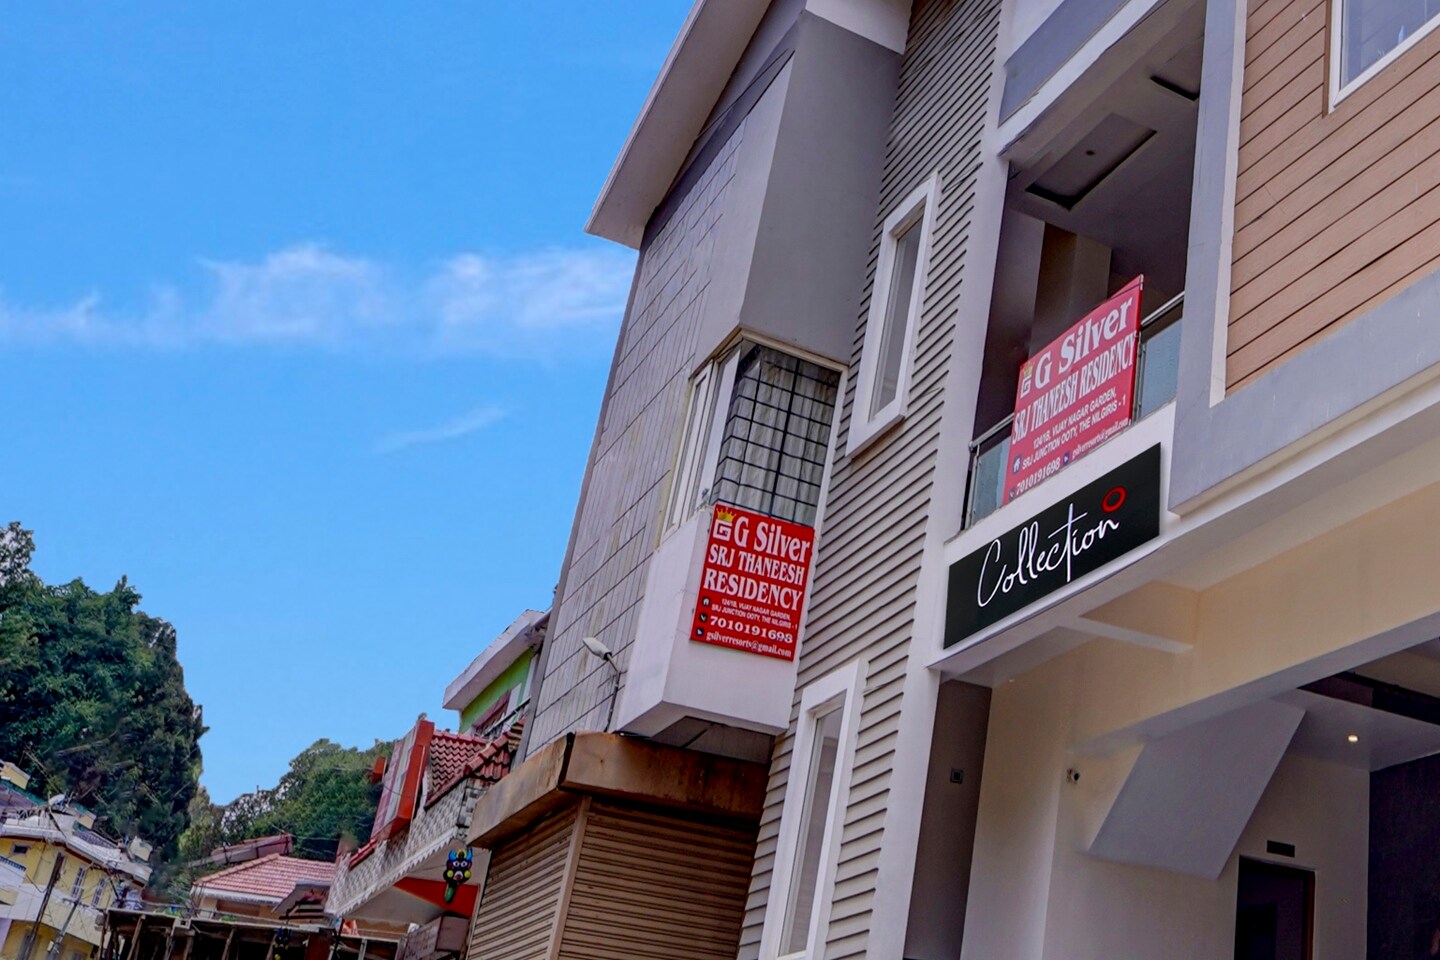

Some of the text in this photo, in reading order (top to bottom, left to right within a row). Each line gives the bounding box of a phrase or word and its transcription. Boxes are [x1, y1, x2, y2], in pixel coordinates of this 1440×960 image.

[1034, 297, 1133, 389] G Silver
[1012, 330, 1138, 445] SRJ THANEESH RESIDENCY
[1022, 453, 1034, 470] SRJ
[1033, 436, 1061, 463] JUNCTION
[1061, 425, 1078, 445] OOTY,
[1079, 416, 1091, 433] THE
[1091, 400, 1118, 426] NILGIRIS
[1052, 417, 1069, 437] VIJAY
[1068, 404, 1089, 427] NAGAR
[1016, 456, 1061, 496] 7010191698
[734, 516, 810, 563] G Silver
[977, 503, 1119, 607] Collection
[708, 543, 805, 585] SRJ THANEESH
[703, 568, 802, 611] RESIDENCY
[752, 604, 770, 615] NAGAR
[710, 615, 793, 644] 7010191698
[711, 603, 722, 612] SRJ
[722, 606, 746, 618] JUNCTION
[761, 615, 772, 624] THE
[771, 618, 792, 629] NILGIRIS
